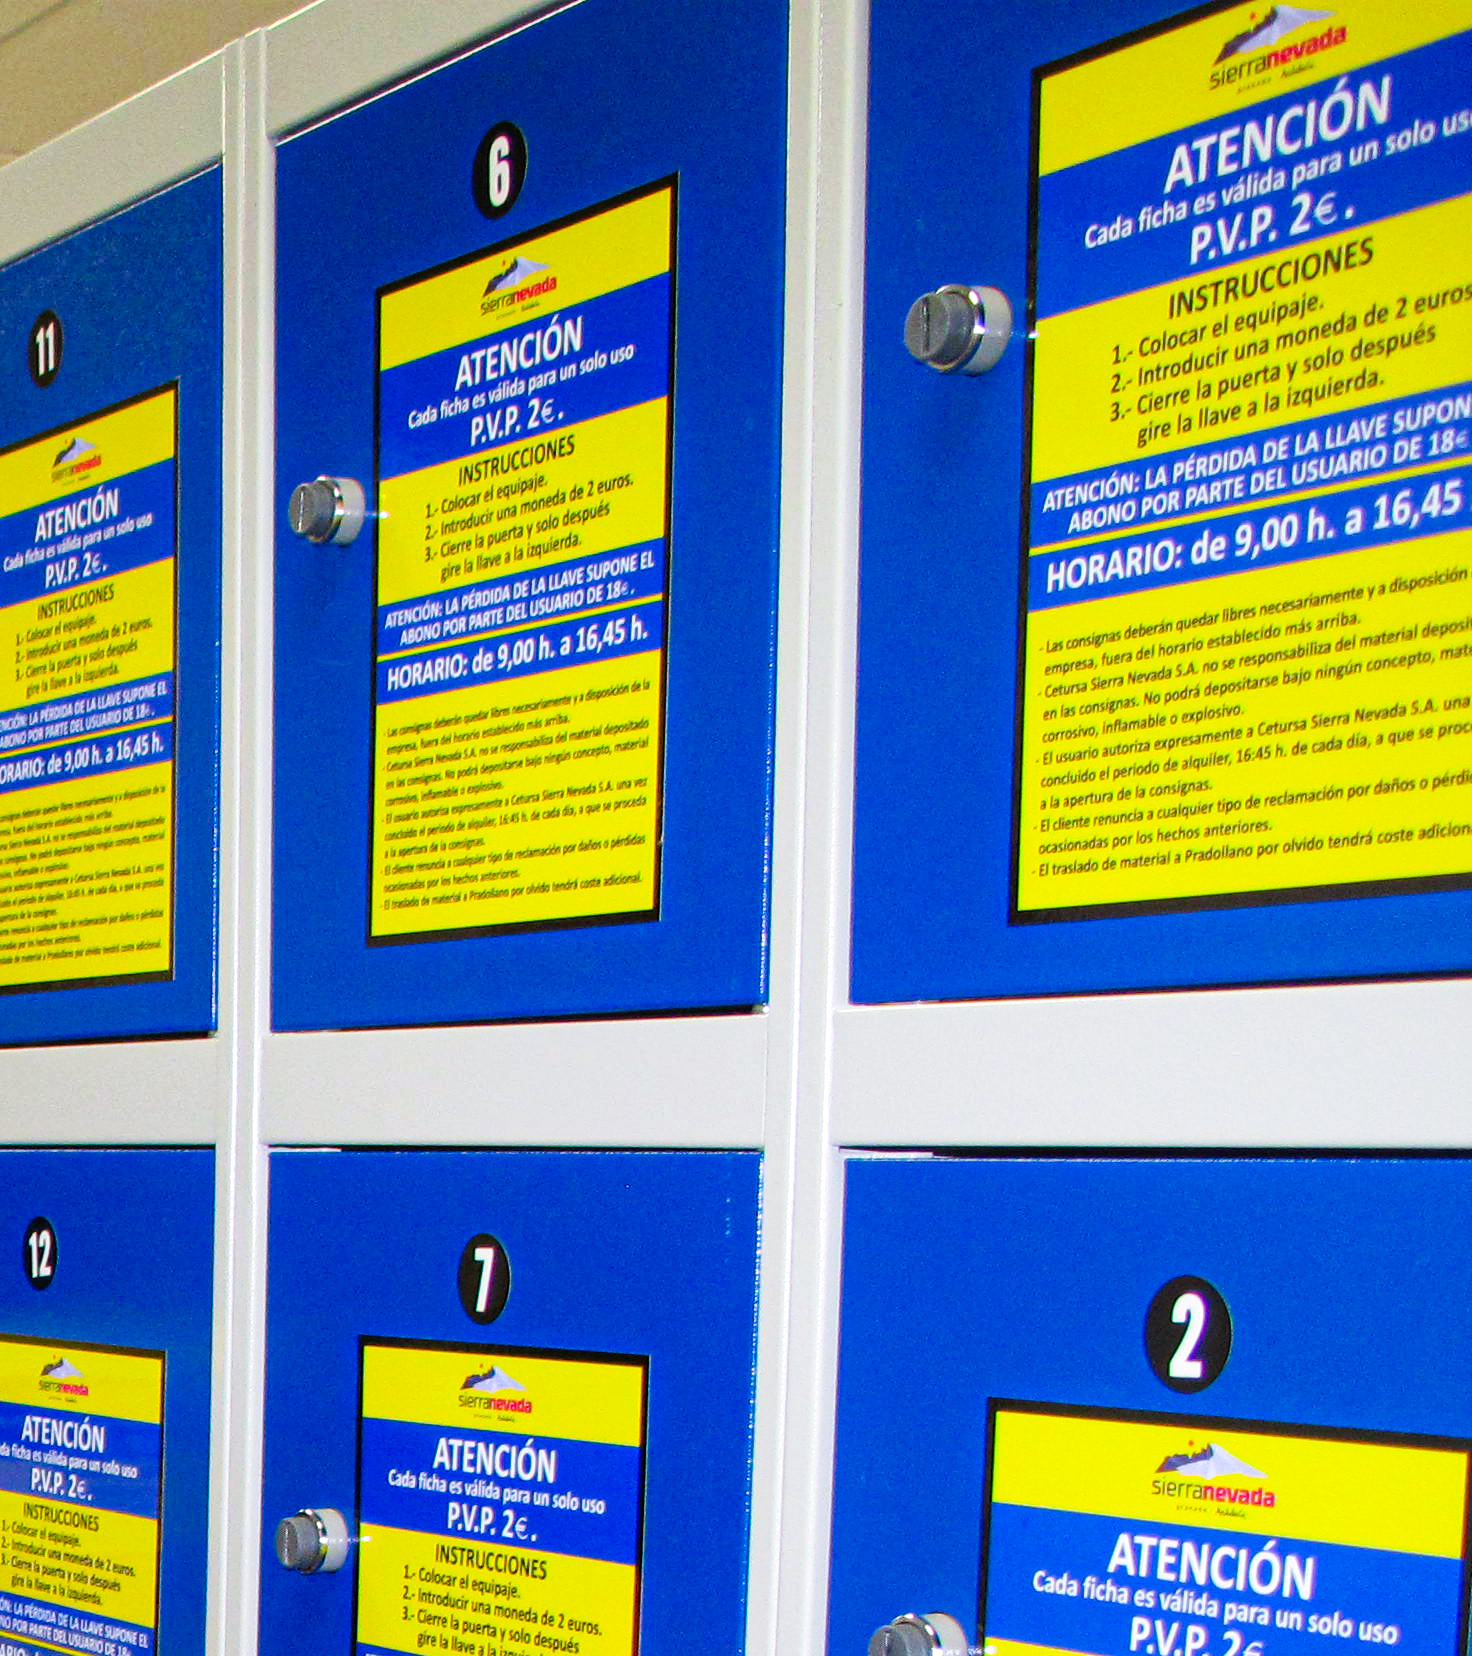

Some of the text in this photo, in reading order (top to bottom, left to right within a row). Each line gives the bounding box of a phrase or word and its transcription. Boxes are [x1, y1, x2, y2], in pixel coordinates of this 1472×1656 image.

[1209, 27, 1344, 90] sierranevada
[1164, 76, 1389, 194] ATENCIÓN
[490, 136, 509, 206] 6
[1191, 204, 1278, 265] P.V.P.
[36, 323, 54, 375] 11
[455, 313, 583, 392] ATENCIÓN
[459, 434, 575, 487] INSTRUCCIONES
[34, 485, 119, 544] ATENCIÓN
[1047, 479, 1463, 594] HORARIO: de 9,00 h. a 16,45
[388, 653, 469, 692] HORARIO:
[1041, 704, 1243, 744] corrosivo, inflamable o explosivo.
[29, 1230, 51, 1277] 12
[475, 1248, 494, 1312] 7
[1170, 1293, 1204, 1378] 2
[21, 1414, 105, 1454] ATENCIÓN
[433, 1437, 557, 1484] ATENCIÓN
[1152, 1480, 1276, 1508] sierranevada
[436, 1543, 547, 1581] INSTRUCCIONES
[1107, 1533, 1315, 1601] ATENCIÓN
[1033, 1570, 1399, 1645] Cada ficha es válida para un solo uso
